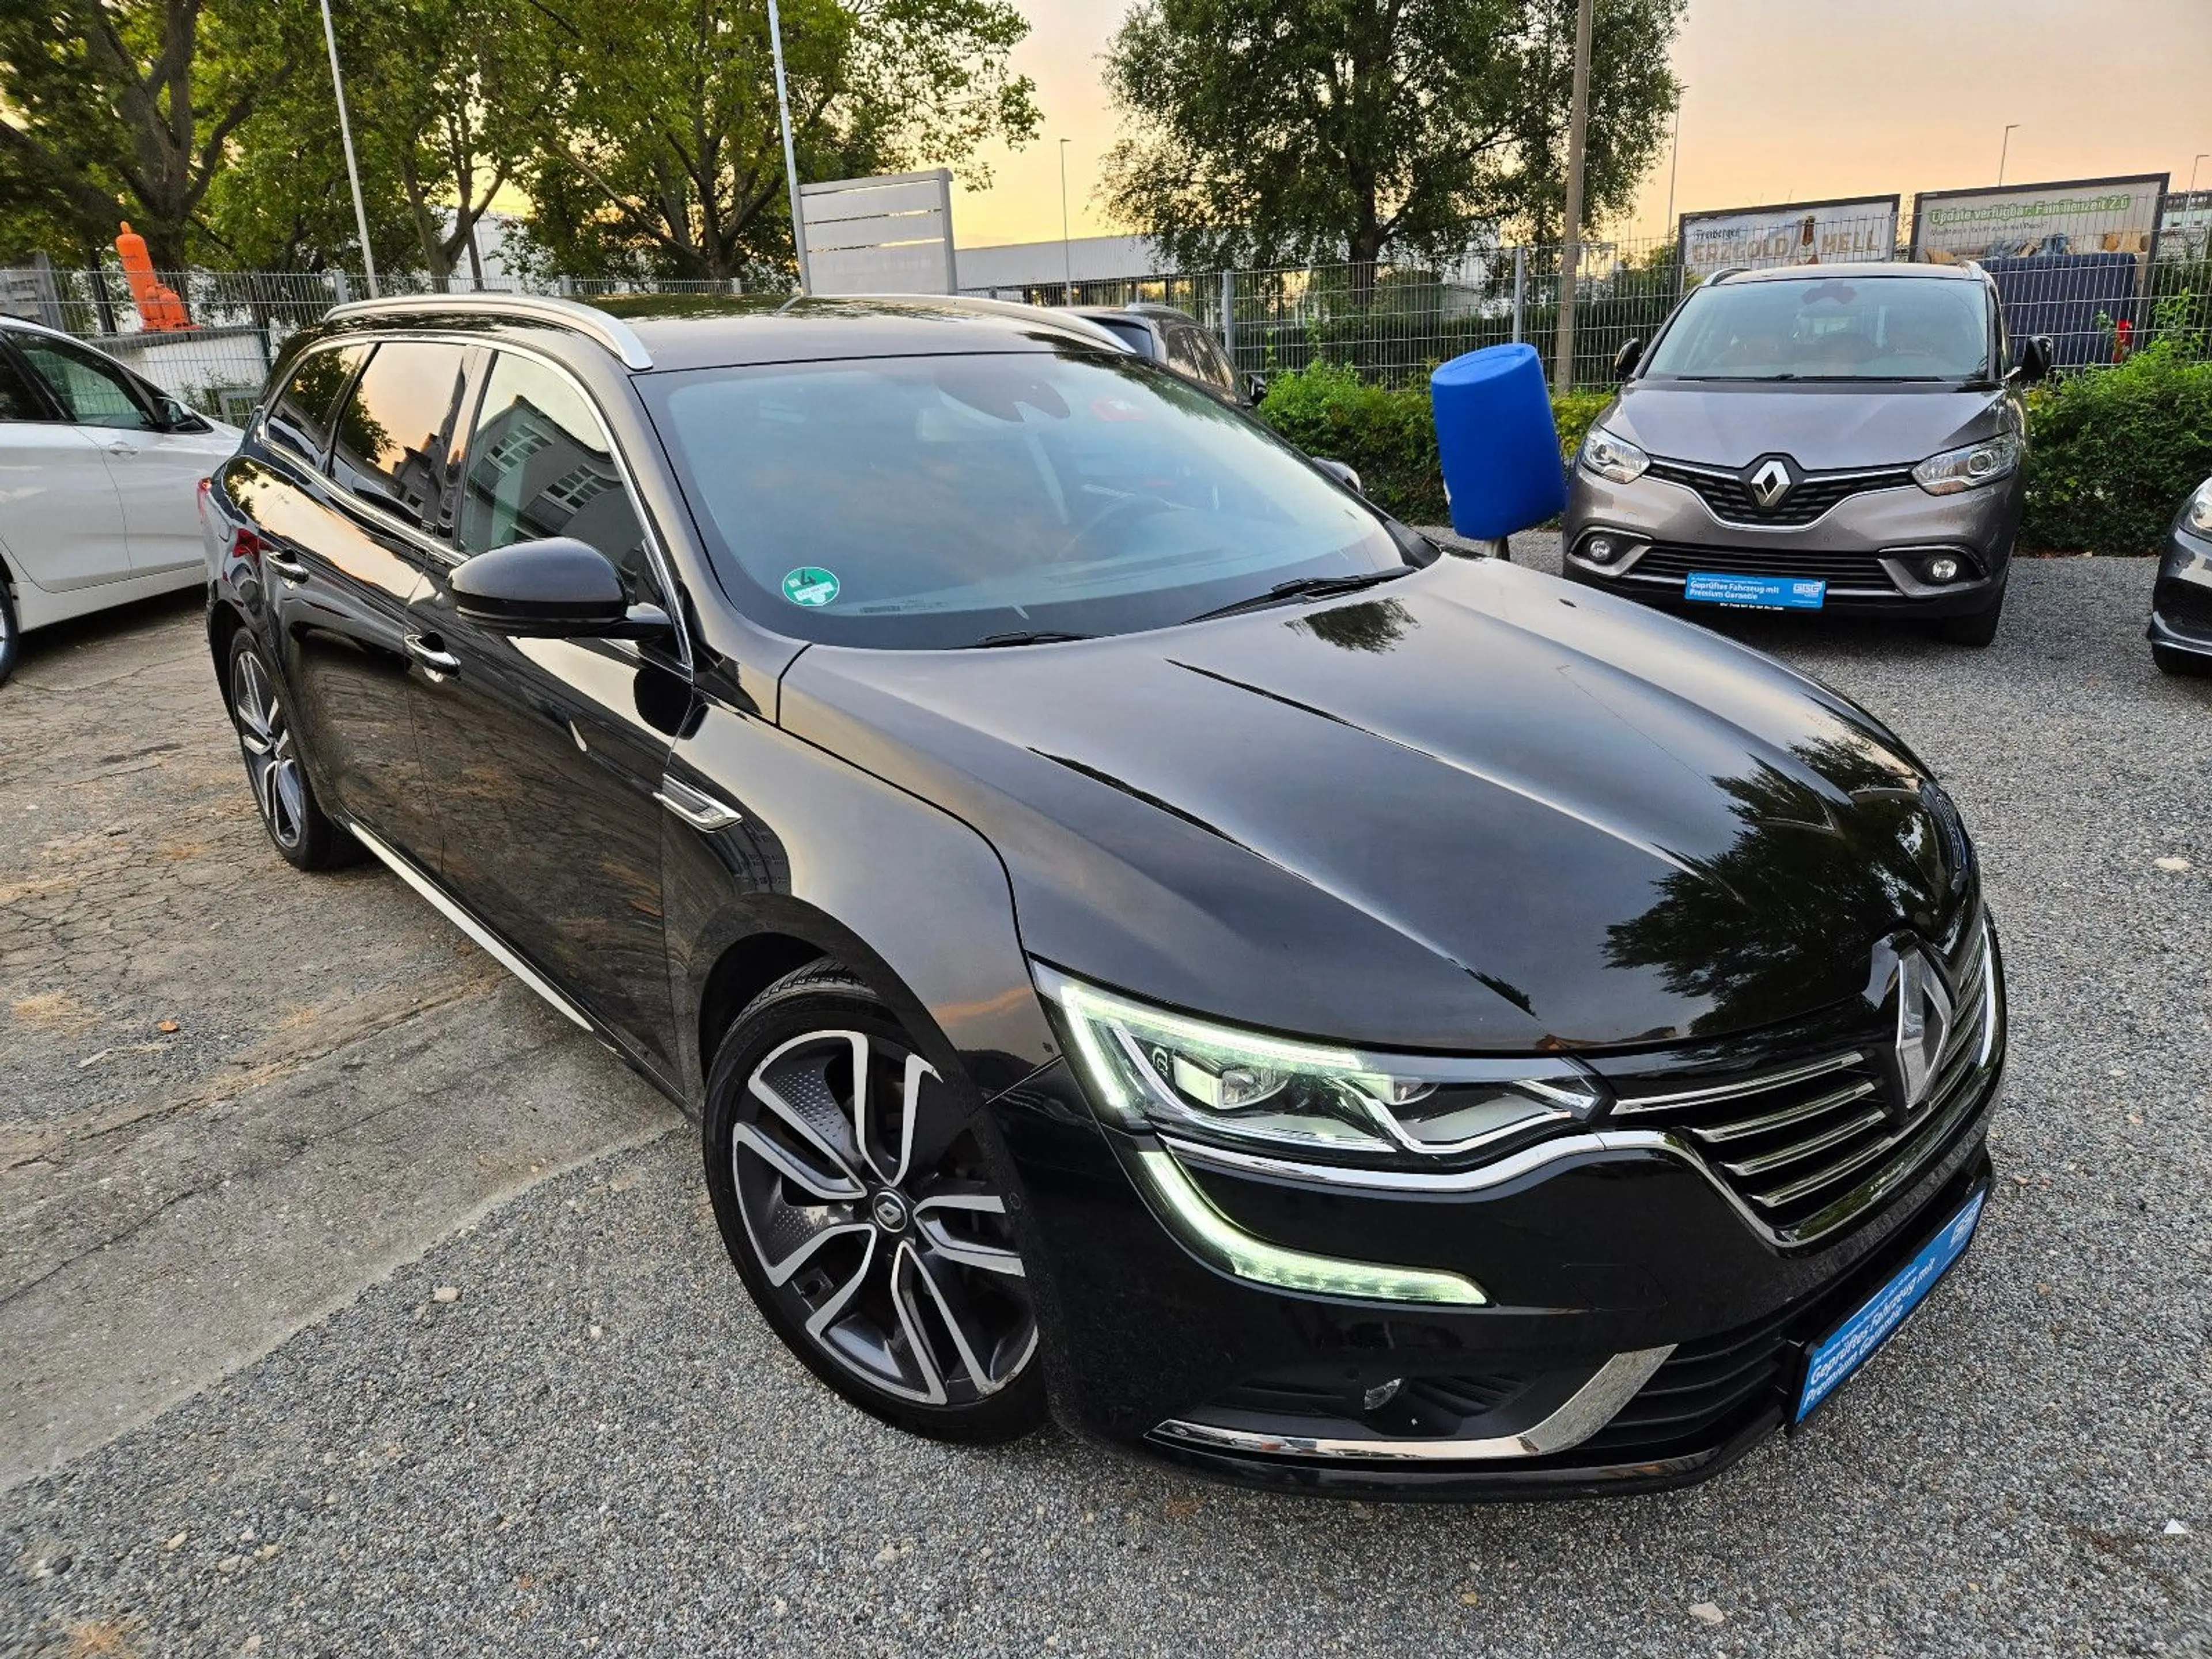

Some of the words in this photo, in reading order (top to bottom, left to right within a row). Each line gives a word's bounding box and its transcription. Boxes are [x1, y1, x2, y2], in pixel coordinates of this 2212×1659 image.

[1930, 209, 1974, 225] Update
[1822, 233, 1878, 252] HELL
[801, 569, 816, 585] 4
